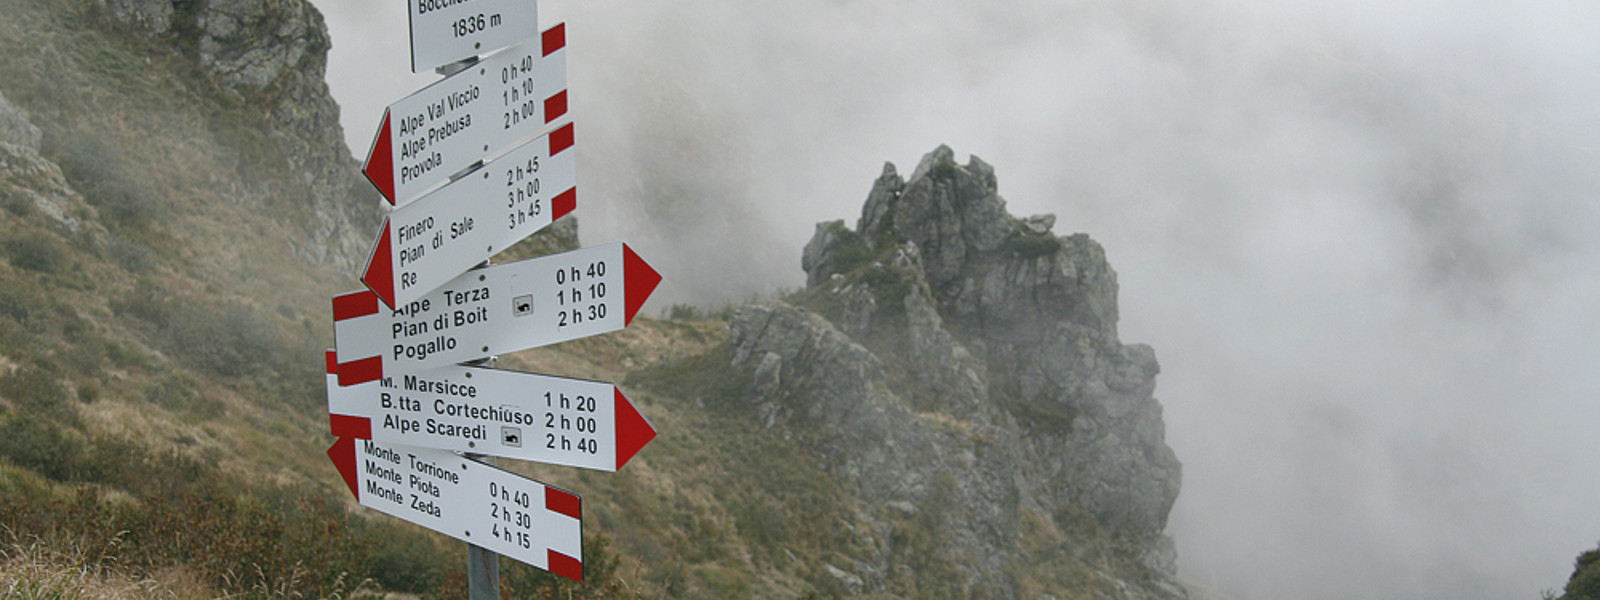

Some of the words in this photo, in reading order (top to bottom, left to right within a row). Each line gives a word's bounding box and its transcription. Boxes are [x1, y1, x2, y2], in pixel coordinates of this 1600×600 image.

[419, 0, 468, 13] Bocc
[452, 14, 485, 38] 1836
[491, 14, 501, 27] m
[400, 114, 424, 137] Alpe
[427, 98, 445, 121] Val
[448, 84, 480, 111] Viccio
[502, 67, 508, 84] 0
[511, 64, 518, 80] h
[521, 56, 532, 73] 40
[401, 137, 426, 160] Alpe
[428, 114, 471, 146] Prebusa
[503, 90, 508, 106] 1
[512, 86, 518, 102] h
[522, 78, 533, 96] 10
[401, 152, 442, 184] Provola
[504, 112, 510, 129] 2
[513, 109, 520, 124] h
[522, 100, 534, 118] 00
[398, 216, 434, 244] Finero
[507, 170, 512, 186] 2
[516, 166, 523, 181] h
[526, 156, 539, 174] 45
[400, 244, 424, 267] Pian
[432, 230, 444, 250] di
[450, 216, 474, 240] Sale
[508, 192, 514, 208] 3
[518, 188, 524, 204] h
[527, 178, 540, 198] 00
[402, 272, 417, 290] Re
[509, 214, 516, 230] 3
[518, 210, 526, 224] h
[528, 200, 542, 218] 45
[392, 321, 428, 340] Pian
[434, 314, 449, 332] di
[454, 306, 488, 327] Boit
[556, 290, 564, 306] 1
[572, 288, 582, 303] h
[588, 282, 606, 299] 10
[444, 287, 490, 307] Terza
[556, 269, 565, 284] 0
[571, 266, 580, 282] h
[587, 261, 606, 278] 40
[394, 336, 456, 360] Pogallo
[558, 311, 567, 327] 2
[573, 308, 582, 323] h
[588, 304, 606, 320] 30
[380, 377, 398, 389] M.
[404, 375, 476, 398] Marsicce
[544, 392, 551, 407] 1
[560, 394, 570, 409] h
[576, 396, 596, 412] 20
[380, 393, 422, 412] B.tta
[434, 399, 534, 425] Cortechiuso
[545, 413, 554, 428] 2
[561, 415, 570, 430] h
[576, 417, 596, 434] 00
[384, 414, 420, 434] Alpe
[426, 419, 486, 440] Scaredi
[546, 433, 555, 448] 2
[562, 435, 571, 450] h
[578, 438, 598, 454] 40
[364, 440, 400, 464] Monte
[408, 454, 459, 484] Torrione
[489, 482, 496, 497] 0
[502, 486, 509, 500] h
[514, 490, 528, 508] 40
[366, 460, 402, 484] Monte
[410, 474, 440, 498] Piota
[491, 504, 498, 518] 2
[504, 507, 510, 522] h
[516, 512, 530, 529] 30
[366, 480, 403, 504] Monte
[410, 494, 441, 518] Zeda
[492, 524, 499, 538] 4
[504, 528, 512, 542] h
[516, 532, 530, 549] 15
